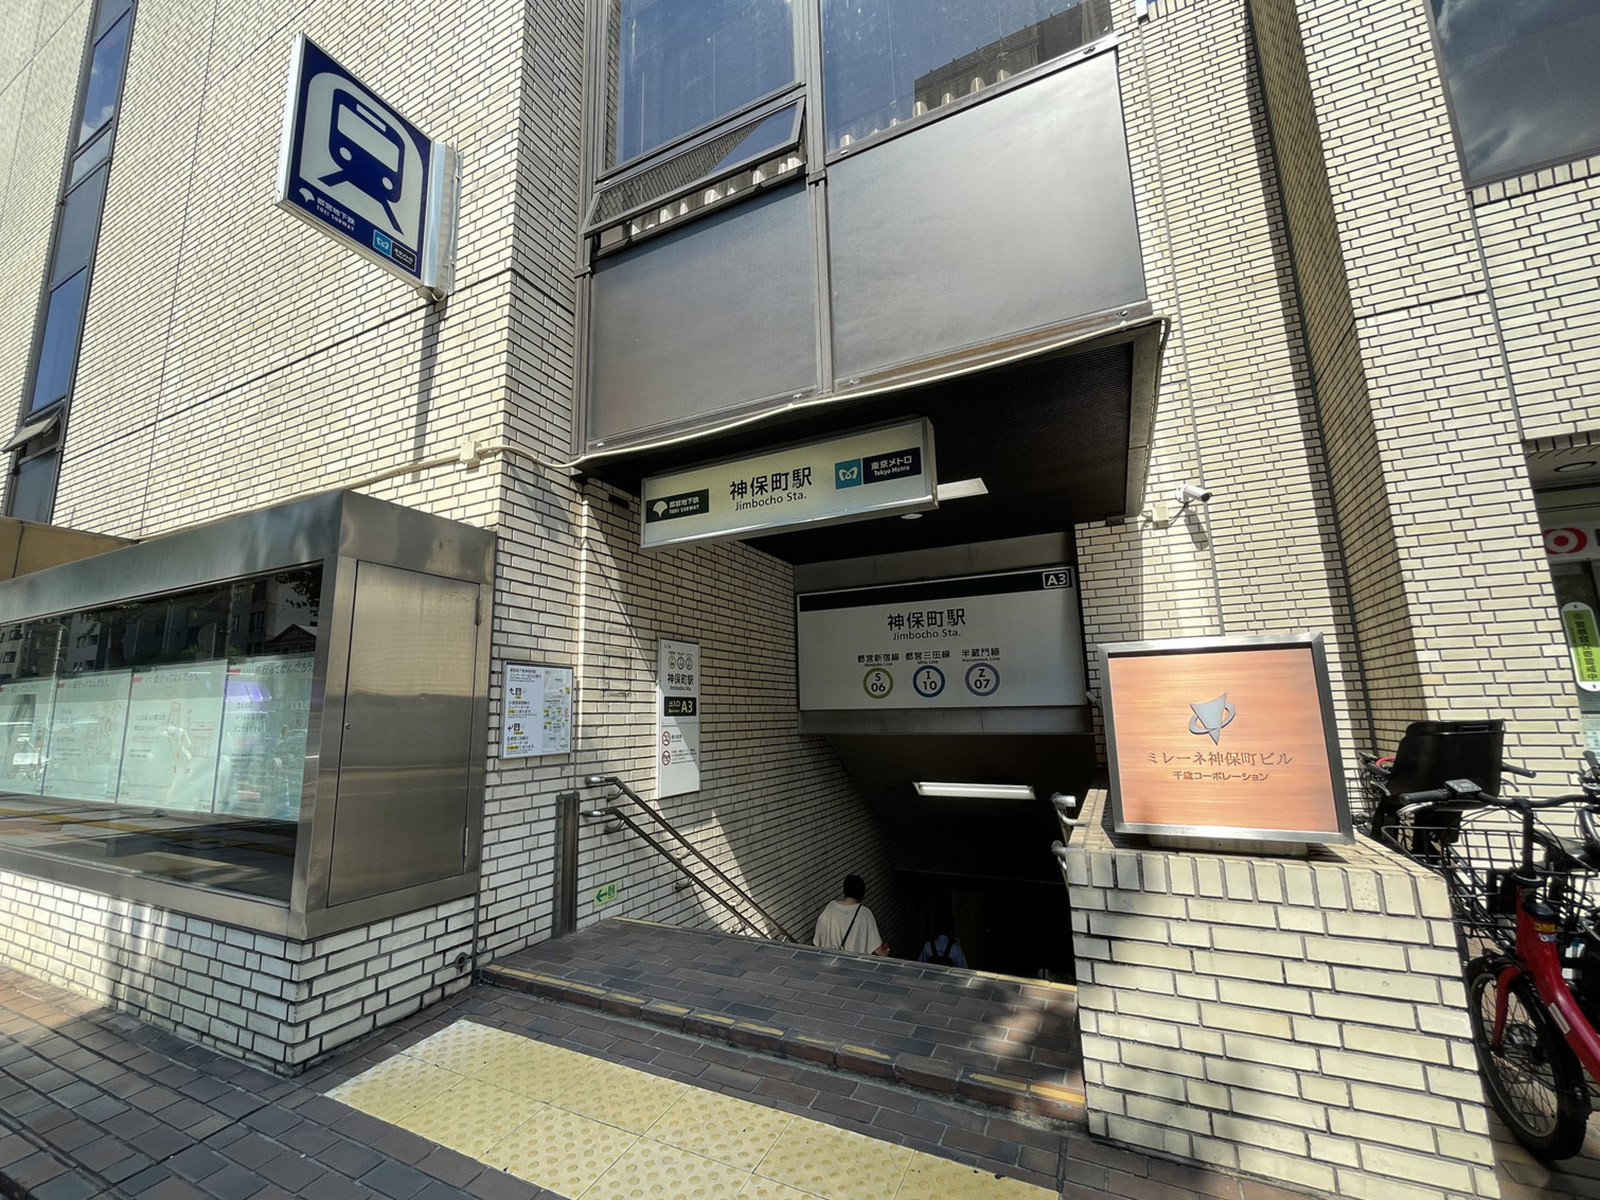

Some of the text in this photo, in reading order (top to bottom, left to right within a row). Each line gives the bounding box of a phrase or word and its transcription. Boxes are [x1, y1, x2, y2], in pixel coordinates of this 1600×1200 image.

[316, 205, 355, 231] TOEI SUBWAY
[871, 455, 912, 471] 東京メトロ
[892, 465, 910, 473] Metro
[729, 466, 812, 501] 神保町駅
[735, 491, 807, 511] Jimbocho Sta.
[680, 504, 700, 512] SUBWAY
[1046, 573, 1066, 586] A3
[887, 608, 966, 631] 神保町駅
[893, 628, 962, 640] Jimbocho Sta.
[857, 653, 899, 663] 都営新宿線
[905, 650, 950, 660] 都営三田線
[961, 647, 1000, 658] 半蔵門線
[875, 673, 881, 681] S
[926, 671, 931, 679] I
[978, 668, 986, 677] Z
[667, 673, 694, 686] 神保町駅
[923, 680, 937, 690] 10
[974, 678, 991, 689] 07
[871, 683, 886, 692] 06
[681, 700, 693, 713] A3
[1147, 751, 1293, 766] ミレーネ神保町ビル
[1172, 771, 1269, 781] 千歳コーポレーション
